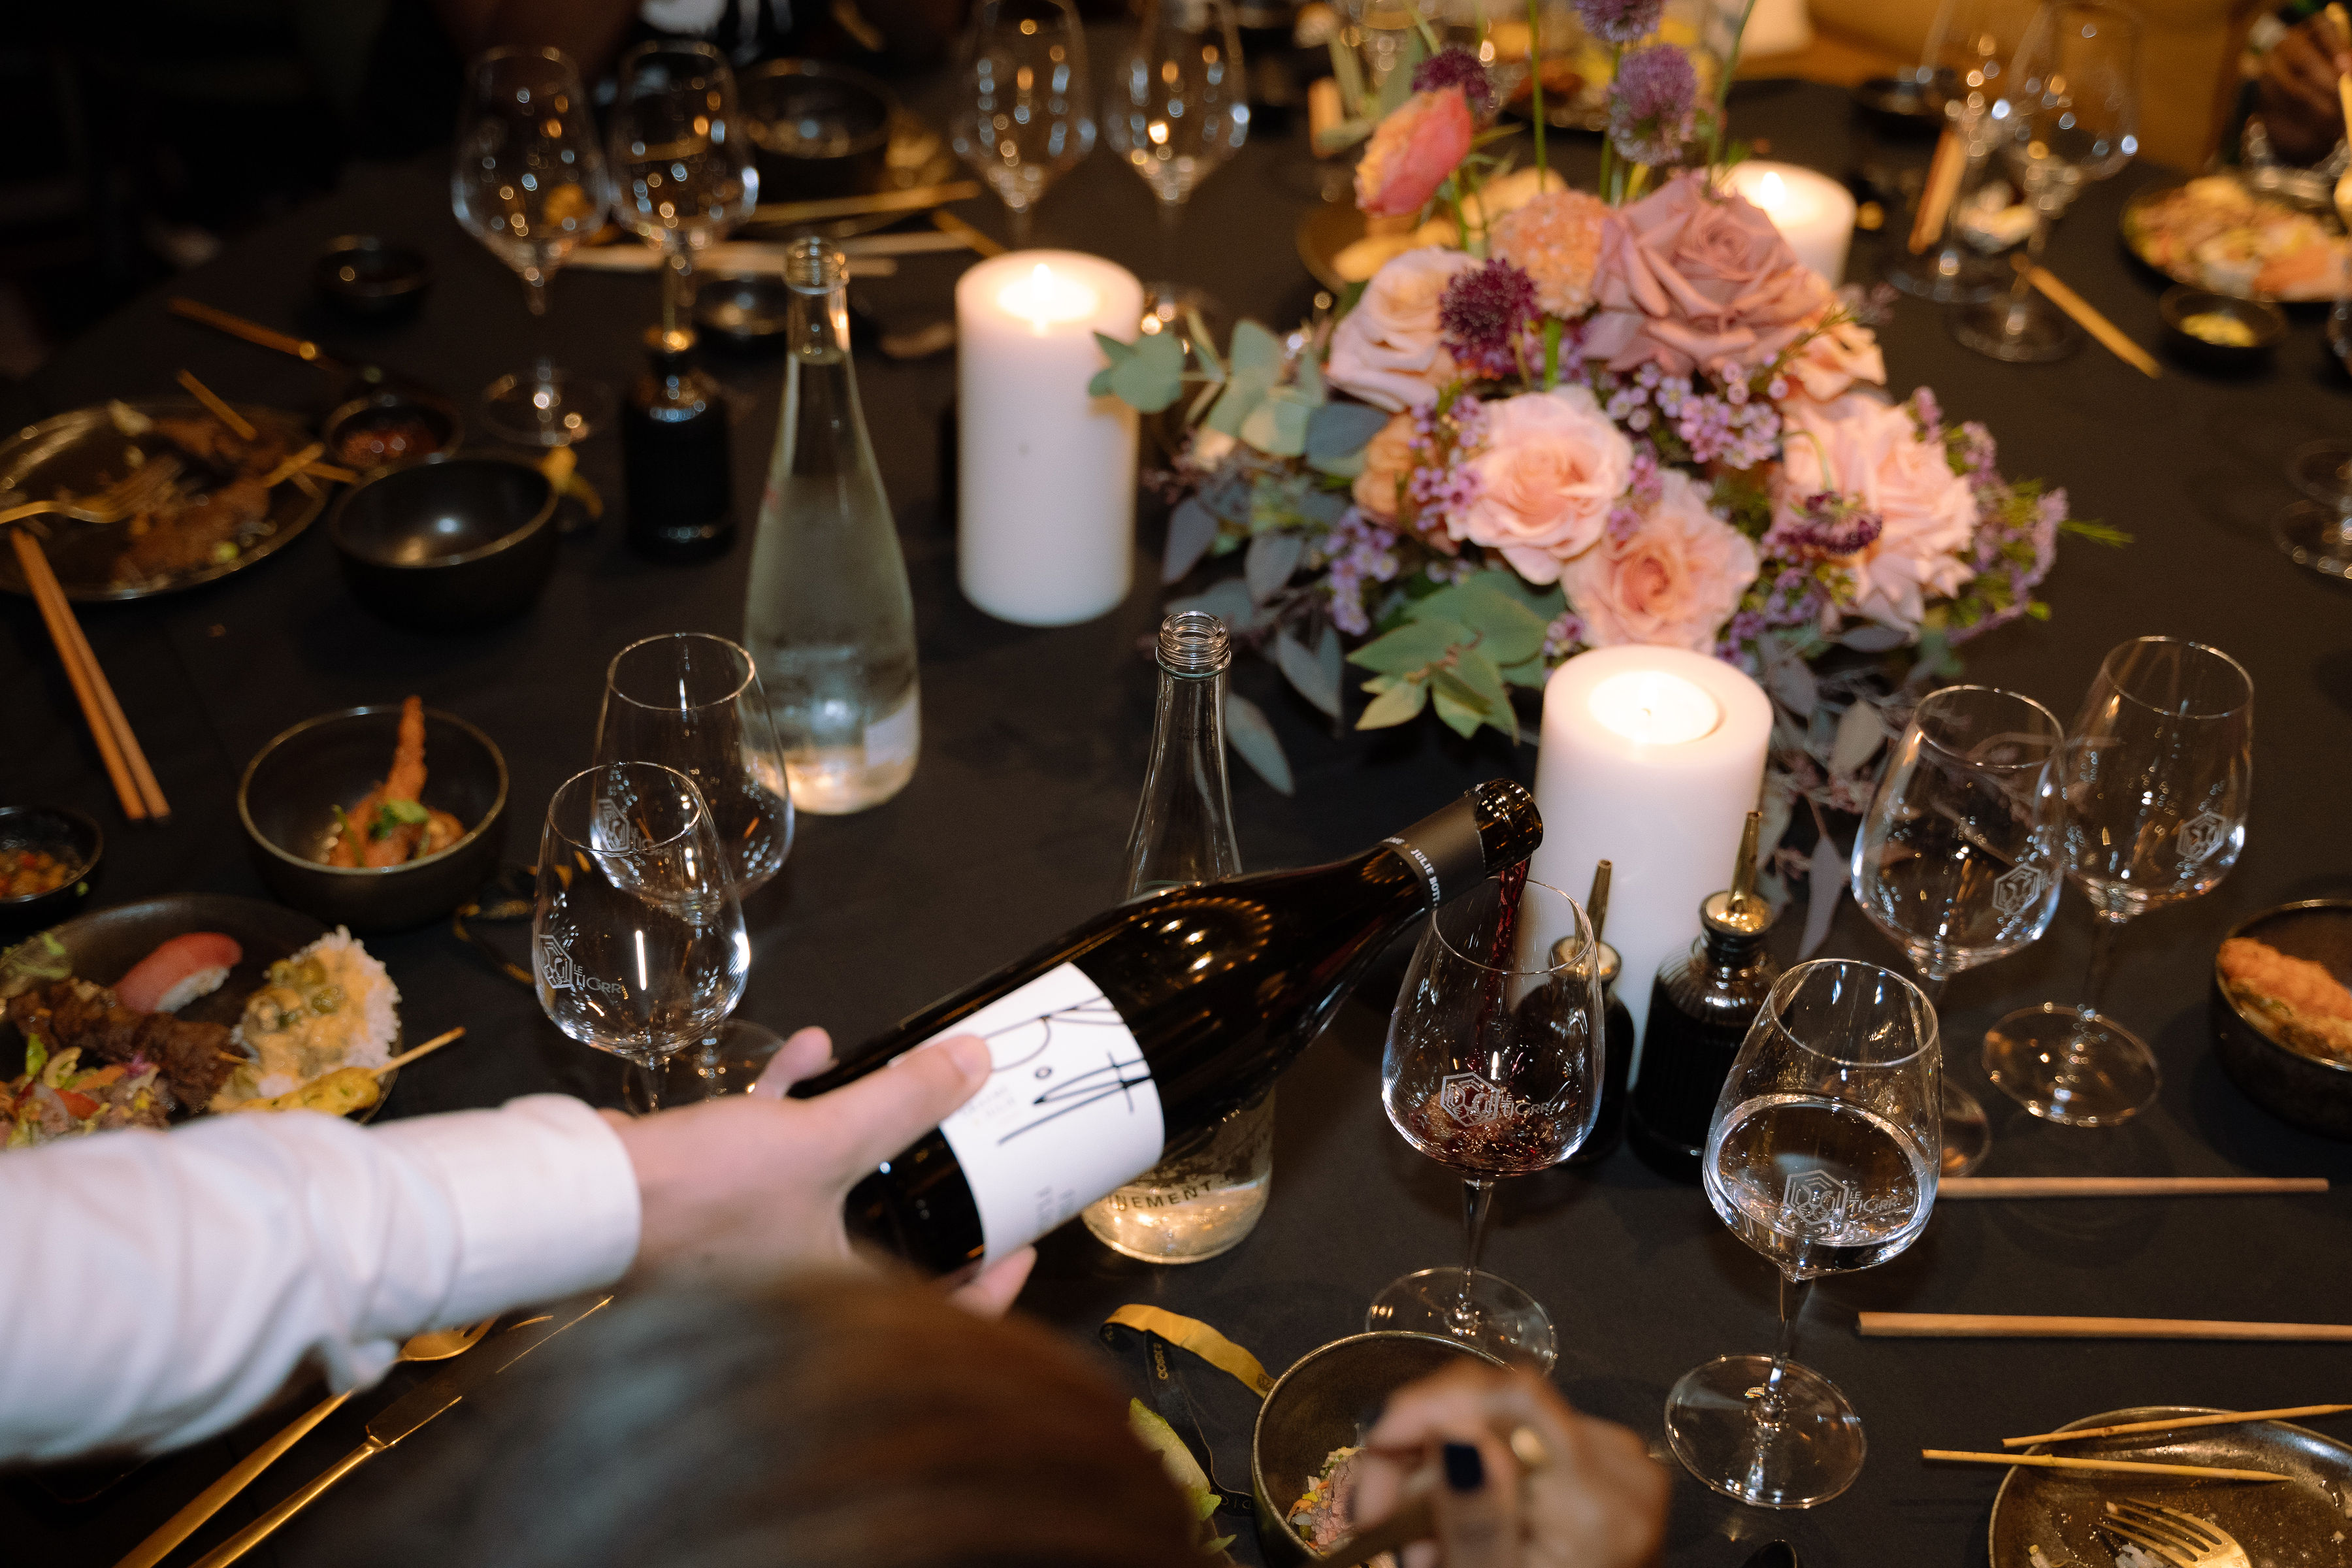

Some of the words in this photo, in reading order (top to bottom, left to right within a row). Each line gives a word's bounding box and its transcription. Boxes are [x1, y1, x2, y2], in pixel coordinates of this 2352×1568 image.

[1411, 849, 1435, 875] JULIE
[573, 964, 583, 973] LE
[1850, 1191, 1861, 1200] LE
